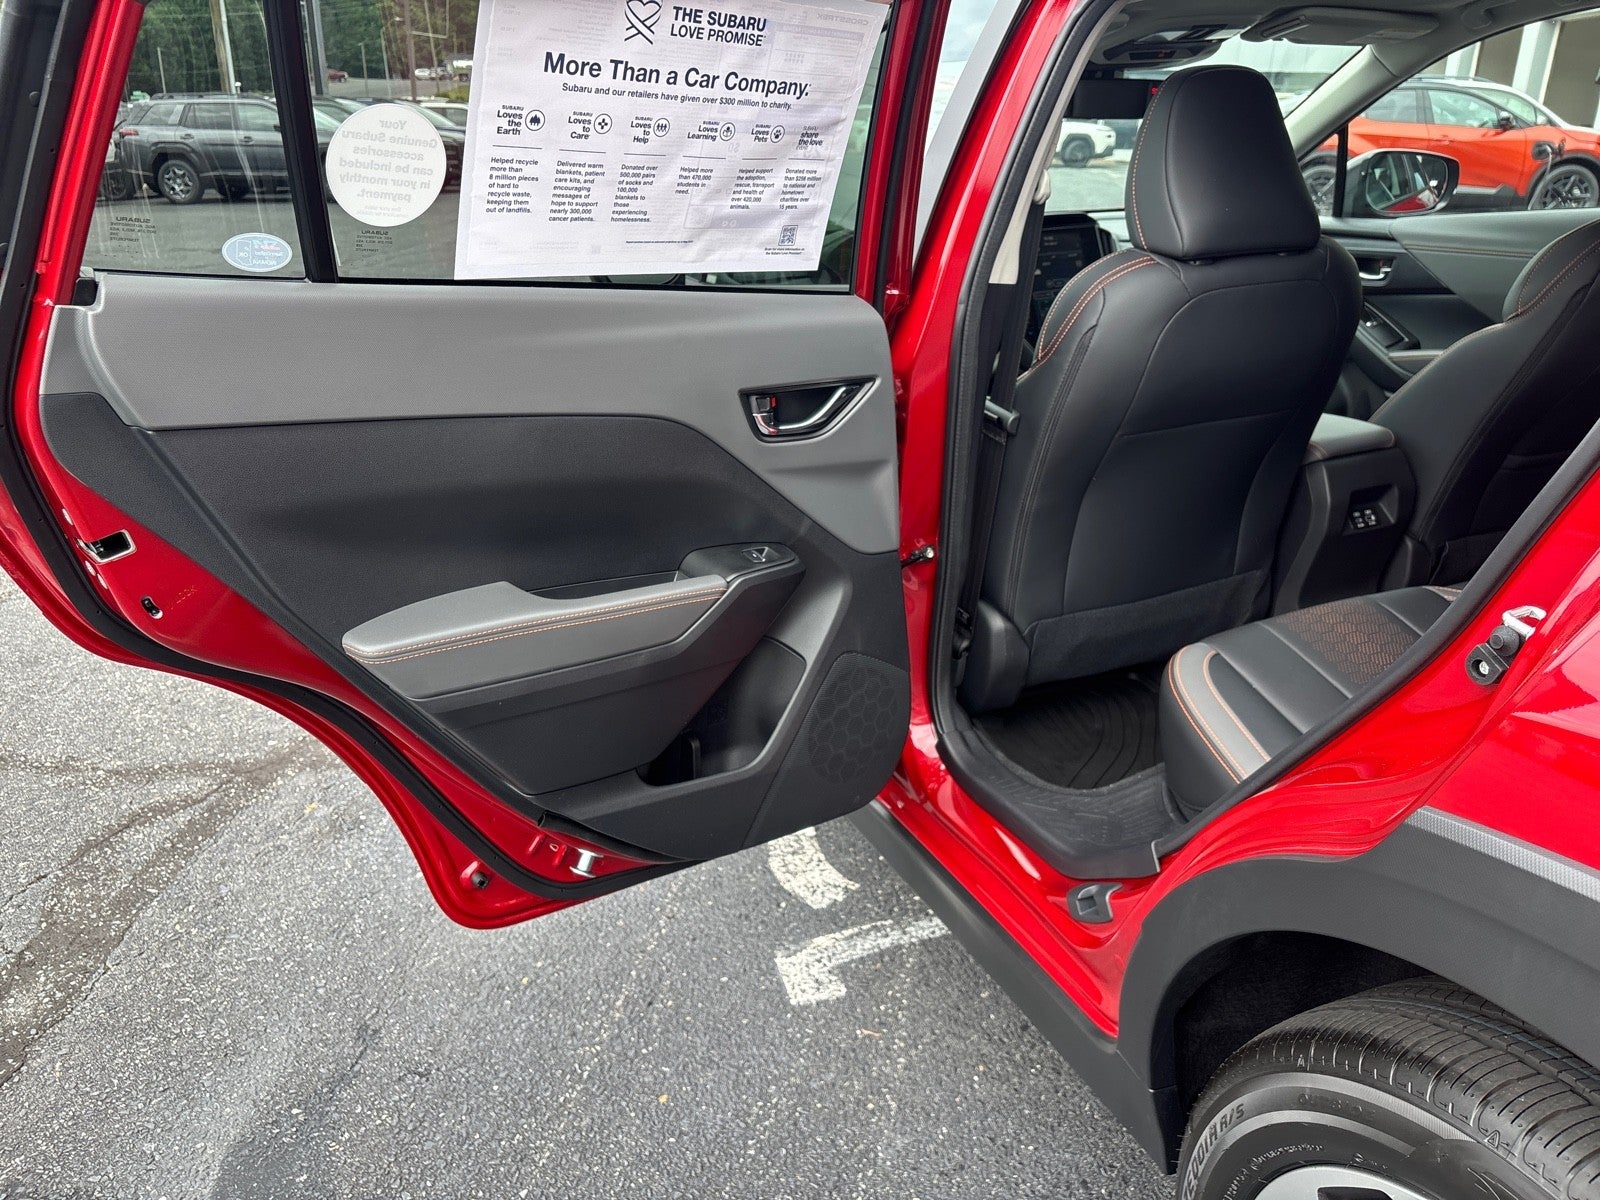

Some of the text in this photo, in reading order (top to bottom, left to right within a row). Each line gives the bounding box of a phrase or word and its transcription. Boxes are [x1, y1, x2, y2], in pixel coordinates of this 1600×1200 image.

[673, 6, 703, 24] THE
[707, 11, 767, 32] SUBARU
[670, 24, 704, 40] LOVE
[543, 52, 602, 79] More
[610, 59, 660, 83] Than
[666, 70, 678, 85] a
[685, 68, 719, 89] Car
[562, 82, 593, 96] Subaru
[595, 86, 610, 96] and
[612, 88, 626, 97] our
[628, 90, 659, 99] retailers
[661, 93, 678, 101] have
[681, 94, 700, 104] given
[719, 97, 735, 106] $300
[737, 98, 760, 107] million
[769, 102, 792, 110] charity.
[497, 110, 523, 119] Loves
[507, 119, 522, 127] the
[568, 116, 592, 125] Loves
[630, 121, 652, 129] Loves
[698, 125, 718, 133] Loves
[496, 127, 521, 135] Earth
[751, 128, 769, 136] Loves
[800, 131, 819, 139] share
[570, 132, 591, 140] Care
[633, 136, 649, 144] Help
[687, 132, 718, 142] Learning
[490, 157, 539, 166] Helped recycle
[557, 160, 586, 168] Delivered
[555, 169, 583, 177] blankets,
[553, 185, 591, 193] encouraging
[486, 199, 512, 207] keeping
[550, 200, 567, 208] hope
